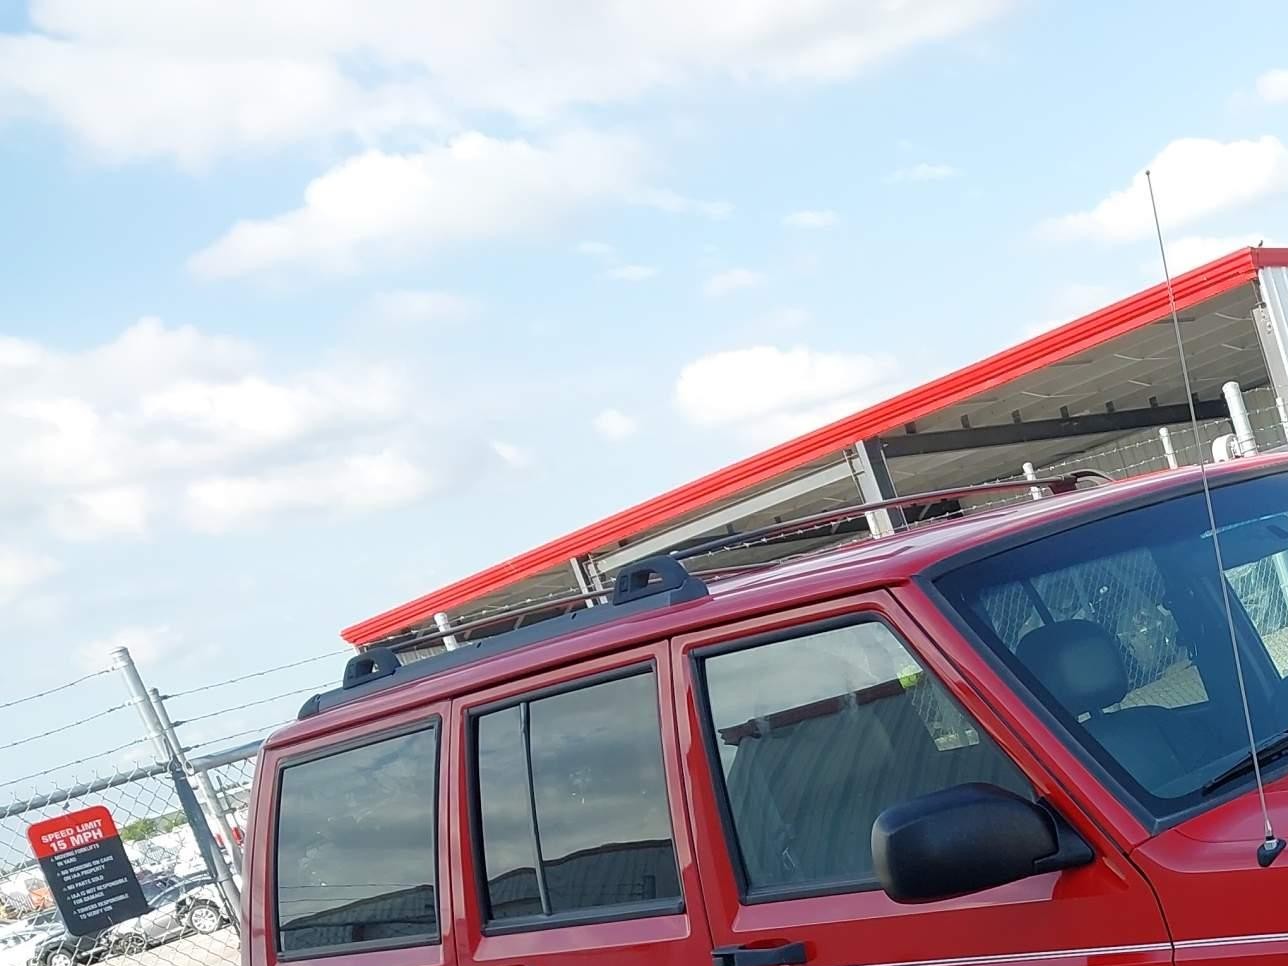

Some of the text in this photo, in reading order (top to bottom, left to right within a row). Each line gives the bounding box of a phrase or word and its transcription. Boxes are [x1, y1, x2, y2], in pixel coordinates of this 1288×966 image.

[41, 819, 102, 843] SPEED LIMIT
[50, 828, 103, 851] 15 MPH
[81, 865, 105, 875] PROPERTY
[75, 879, 91, 888] PARTS
[97, 878, 128, 890] RESPONSIBLE
